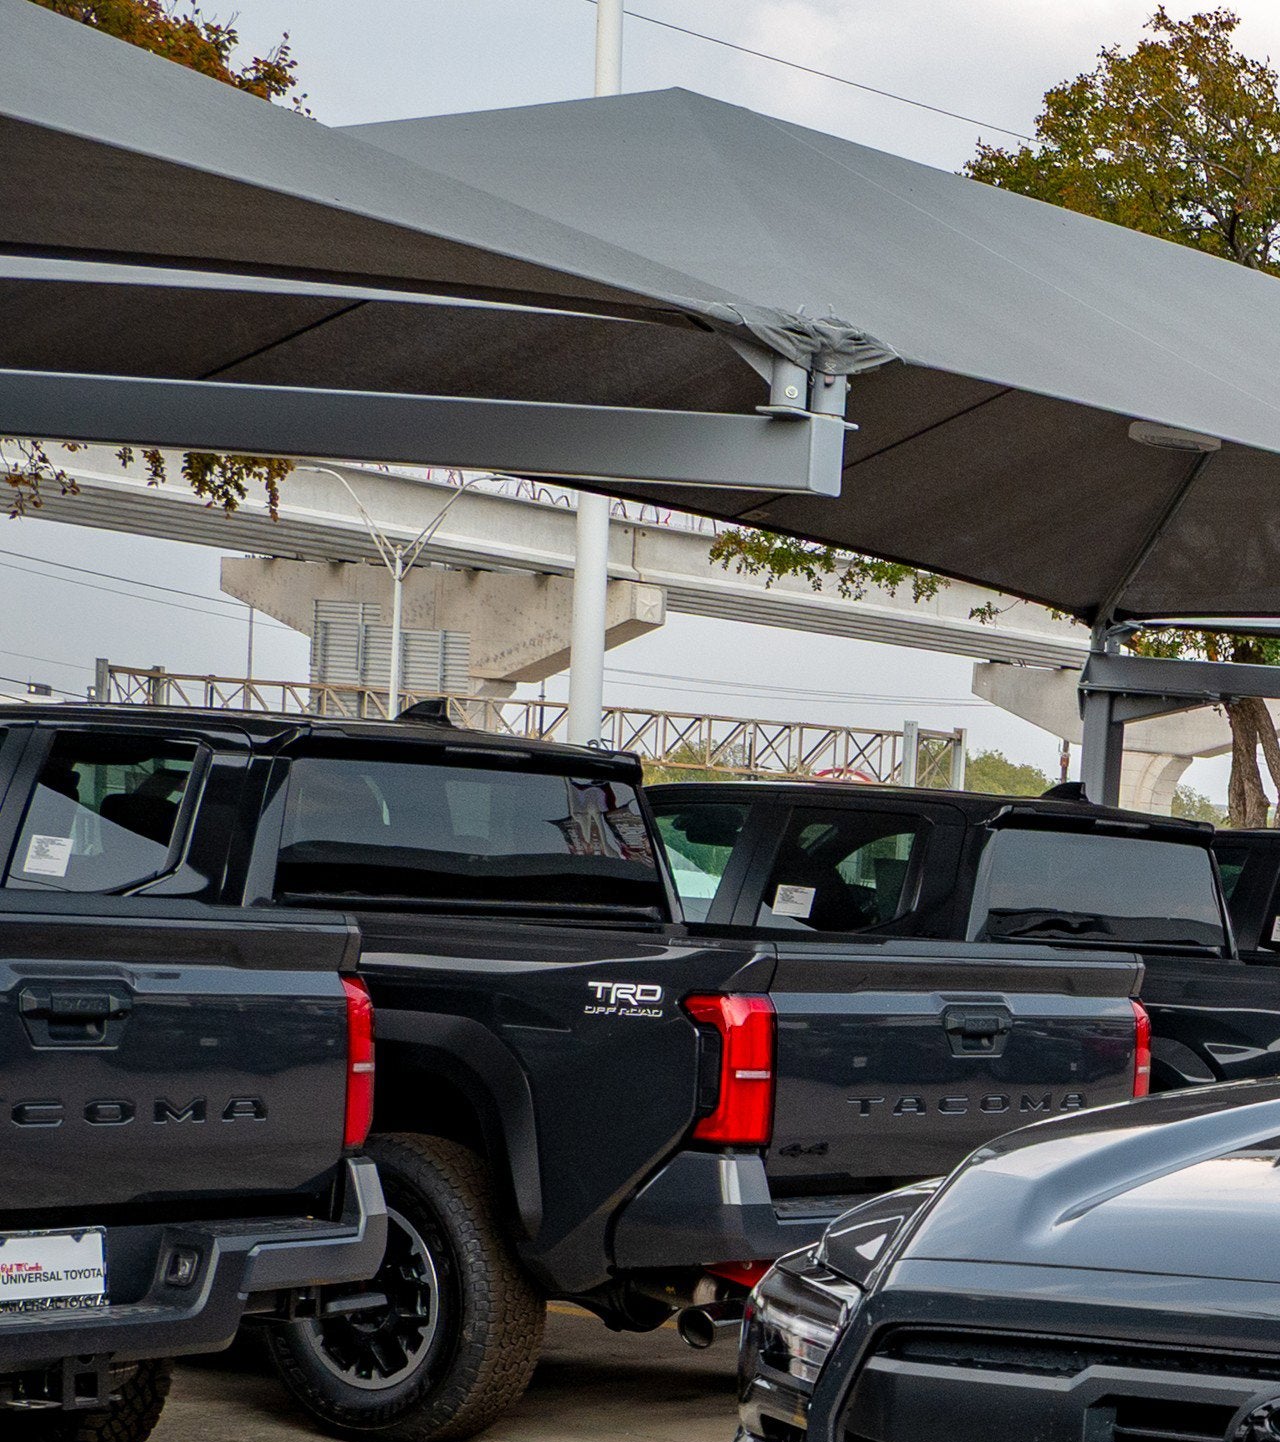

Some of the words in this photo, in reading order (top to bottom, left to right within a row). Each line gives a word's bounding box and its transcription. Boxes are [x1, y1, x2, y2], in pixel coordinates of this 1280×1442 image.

[588, 981, 662, 1005] TRD
[584, 1005, 616, 1015] OFF
[847, 1091, 1087, 1117] TACOMA
[2, 1271, 62, 1285] UNIVERSAL
[64, 1268, 103, 1281] TOYOTA
